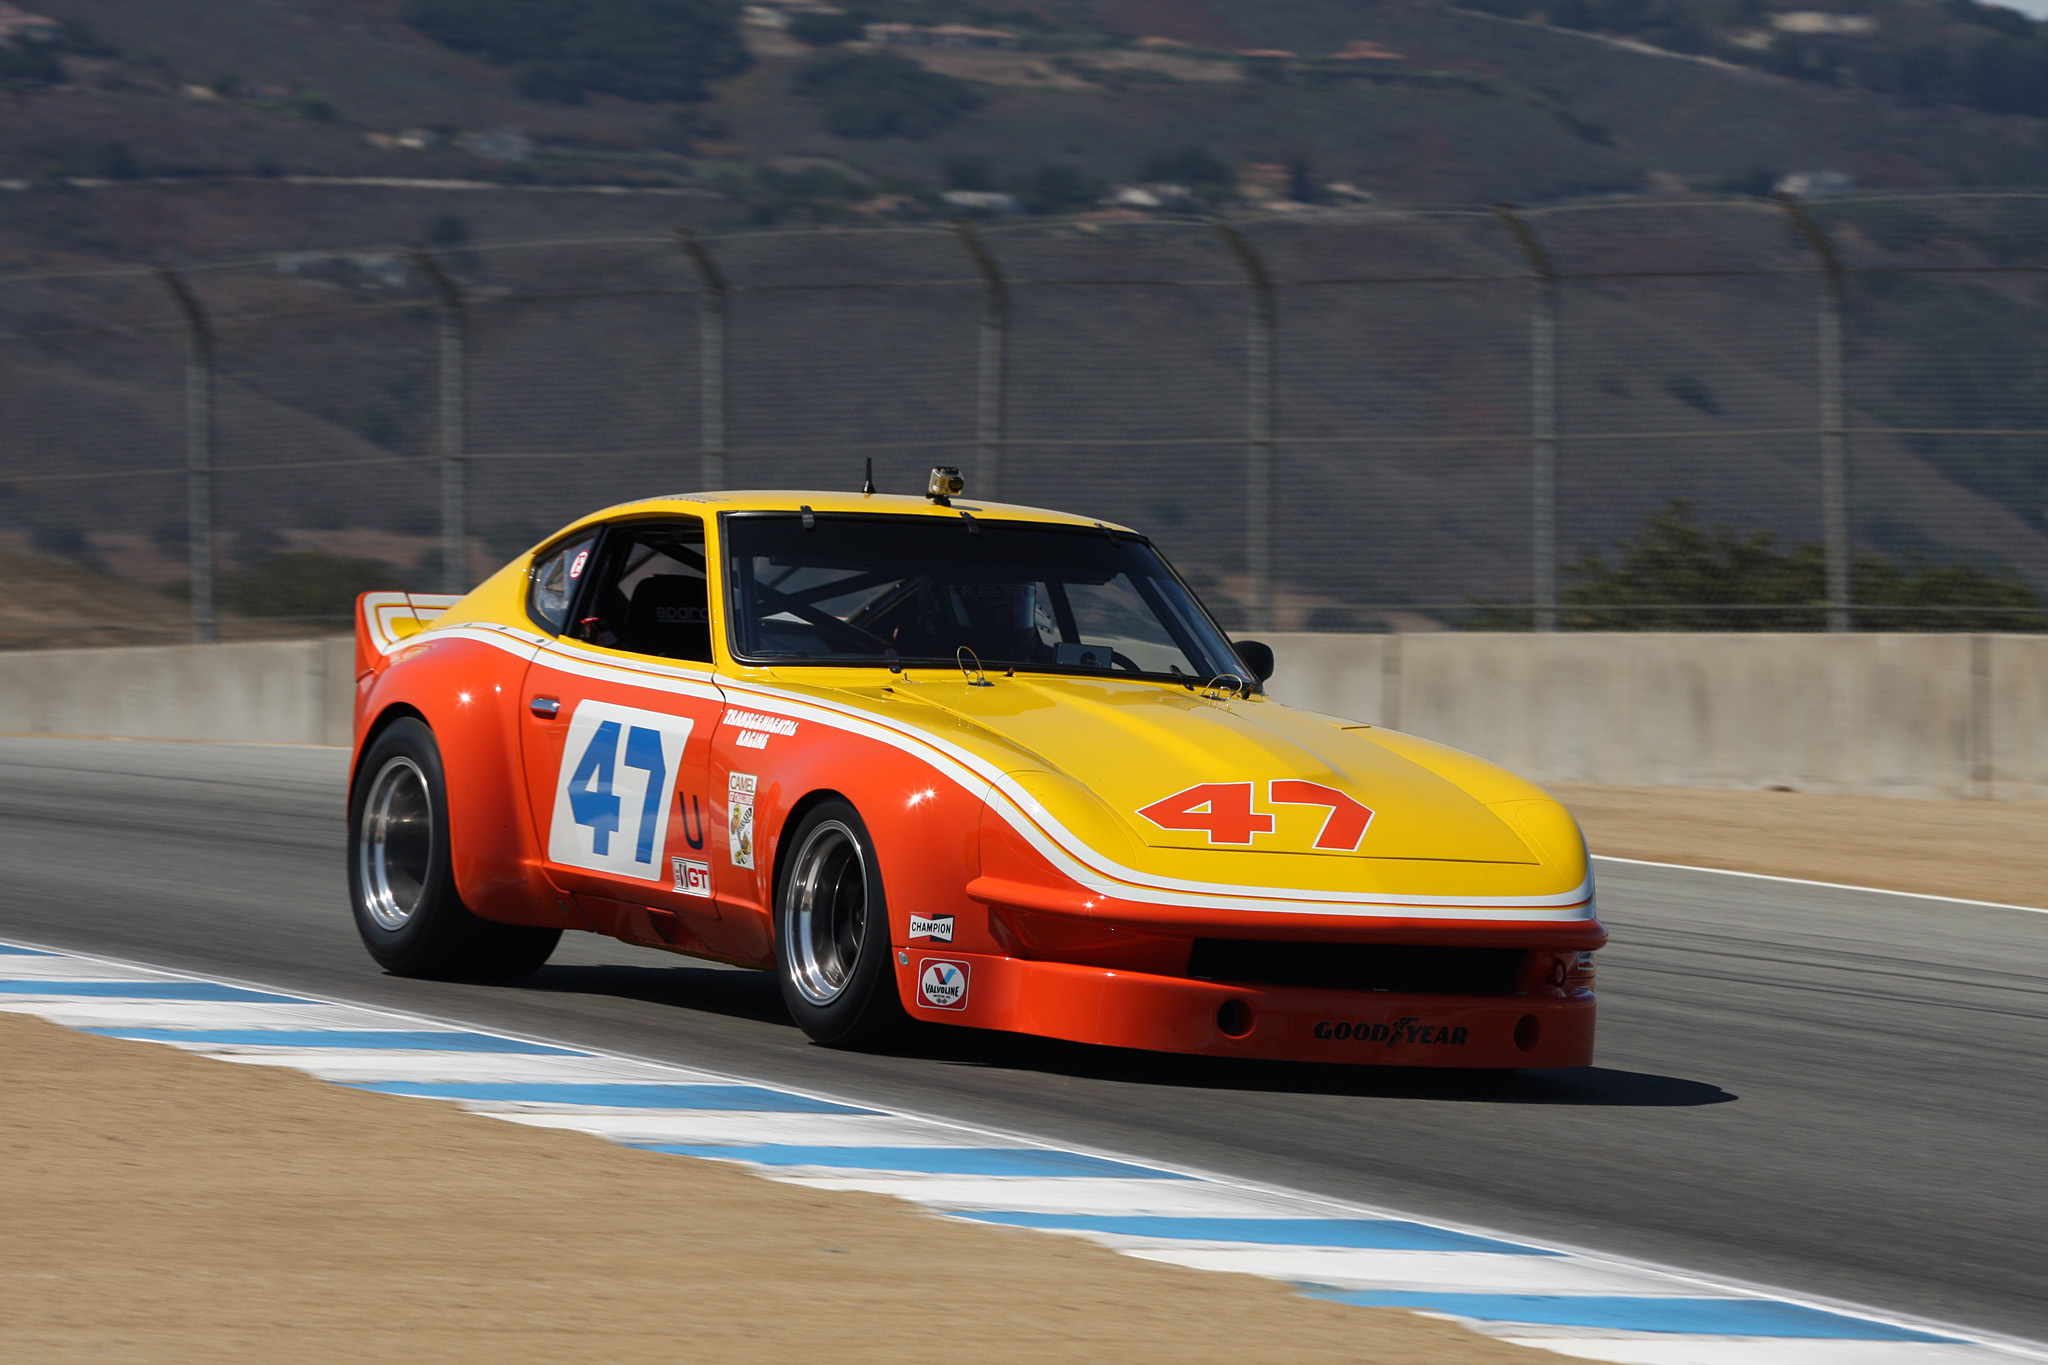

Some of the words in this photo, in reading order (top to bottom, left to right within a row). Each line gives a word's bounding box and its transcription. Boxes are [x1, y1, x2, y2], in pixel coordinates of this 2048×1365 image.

[656, 606, 709, 621] sparc
[722, 708, 800, 737] TRANSCENDENTAL
[735, 729, 770, 750] RACING
[567, 719, 667, 865] 47
[730, 775, 754, 793] CAMEL
[679, 791, 704, 851] U
[1133, 778, 1377, 852] 47
[687, 867, 709, 889] GT
[911, 922, 951, 934] CHAMPION
[925, 983, 960, 997] VALVOLINE
[1314, 1019, 1469, 1046] GOODYEAR
